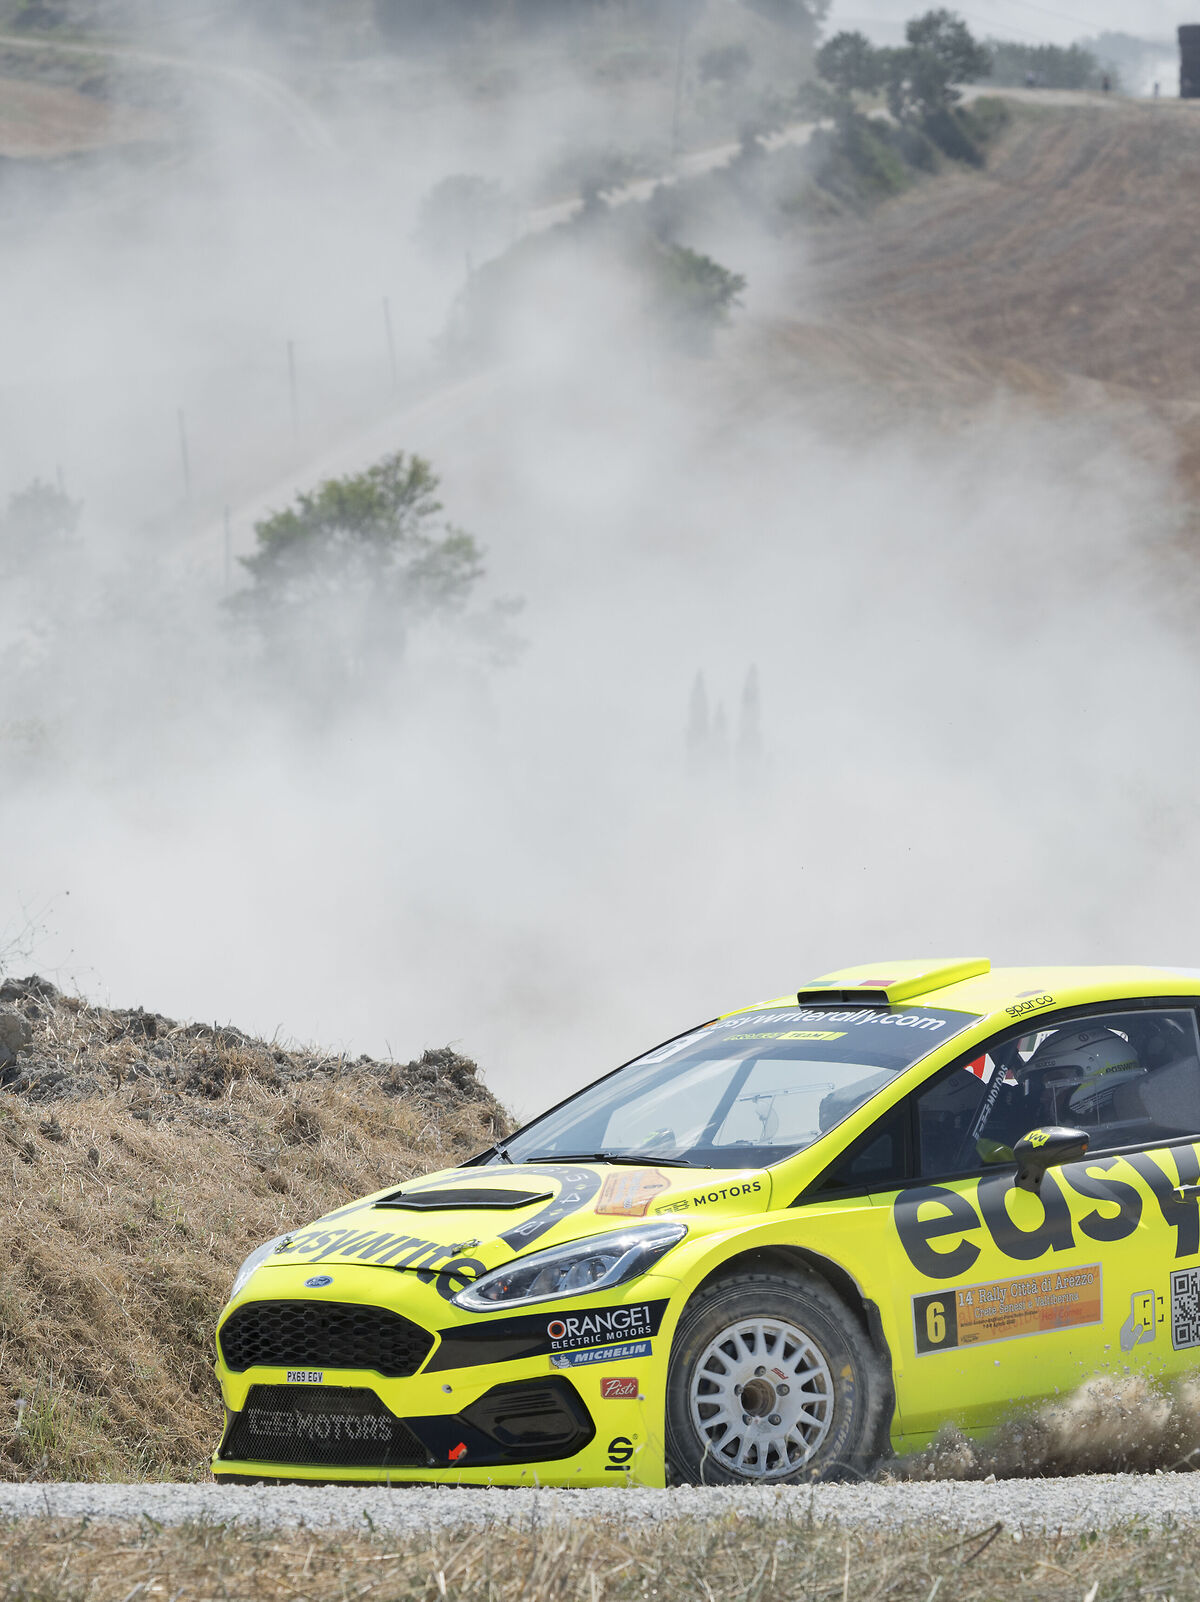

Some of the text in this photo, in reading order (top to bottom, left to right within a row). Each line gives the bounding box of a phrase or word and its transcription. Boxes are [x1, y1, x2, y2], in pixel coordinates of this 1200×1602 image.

[1005, 995, 1053, 1017] sparco
[988, 1063, 1010, 1106] MOTORS
[693, 1180, 762, 1207] MOTORS
[978, 1285, 1008, 1304] Rally
[1010, 1279, 1038, 1298] Città
[1041, 1277, 1052, 1293] di
[1055, 1273, 1094, 1291] Arezzo
[547, 1306, 650, 1340] ORANGE1
[926, 1301, 946, 1344] 6
[974, 1306, 997, 1319] Crete
[999, 1301, 1026, 1314] Senesi
[551, 1325, 652, 1350] ELECTRIC MOTORS
[574, 1343, 647, 1363] MICHELIN
[287, 1371, 323, 1383] PX69 EGV
[604, 1379, 636, 1397] Pisti
[296, 1410, 393, 1442] MOTORS
